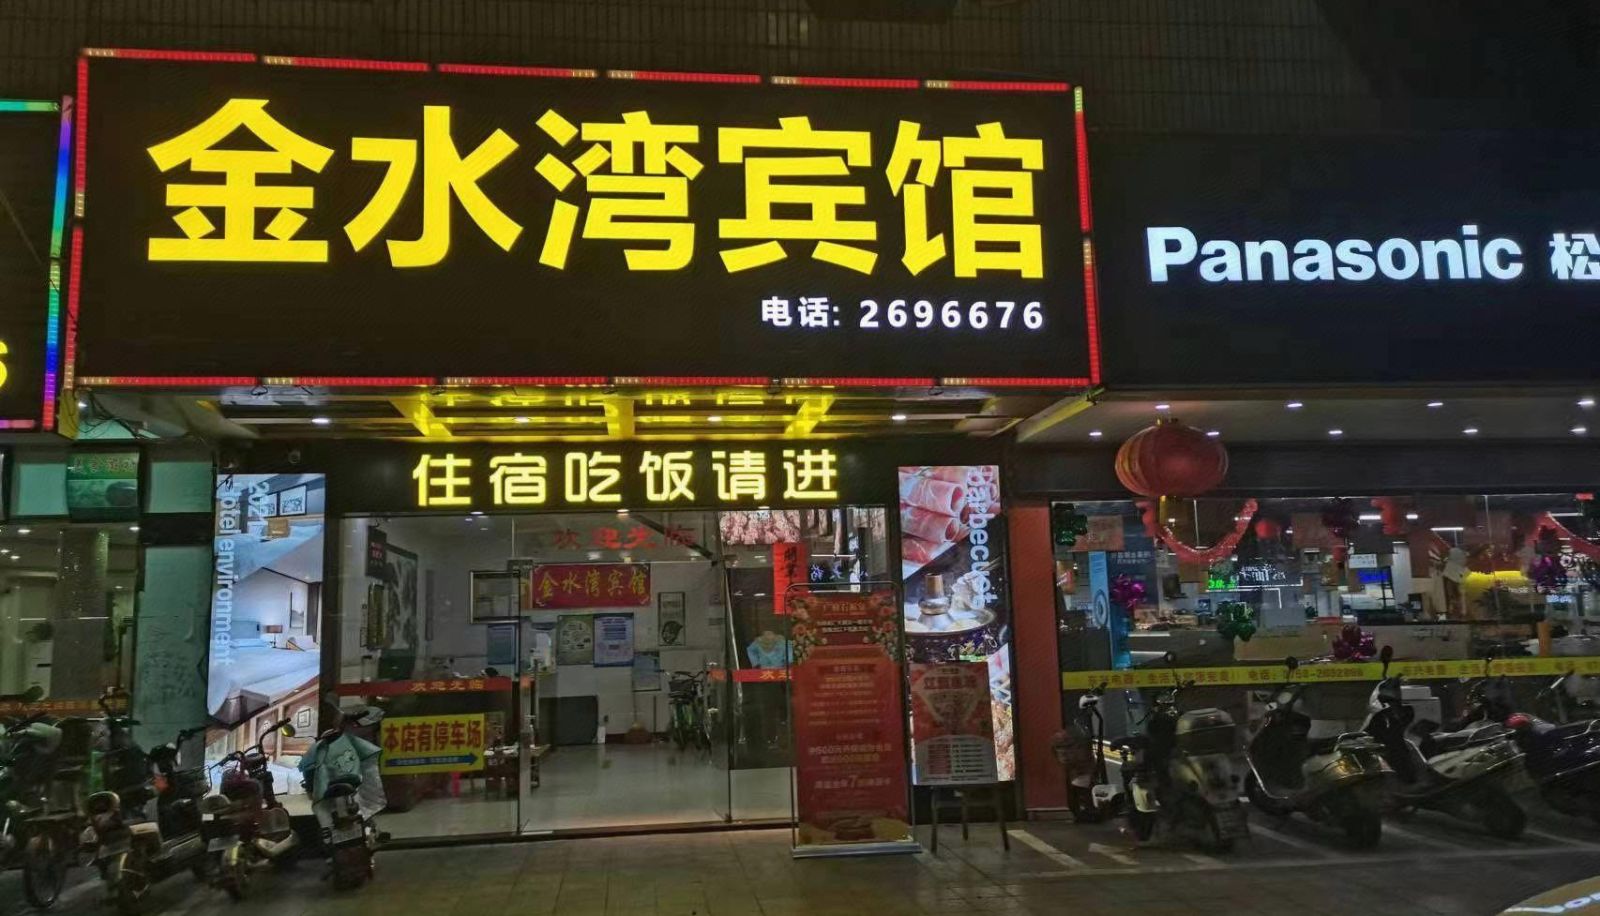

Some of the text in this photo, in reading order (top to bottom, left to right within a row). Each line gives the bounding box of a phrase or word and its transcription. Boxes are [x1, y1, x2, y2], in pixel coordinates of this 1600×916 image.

[147, 98, 1044, 279] 金水湾宾馆
[1146, 225, 1523, 282] Panasonic
[761, 297, 1044, 329] 电话: 2696676
[413, 449, 838, 506] 住宿吃饭请进
[214, 538, 240, 666] environment
[539, 568, 647, 598] 金水湾宾馆
[384, 721, 482, 753] 本店有停车场
